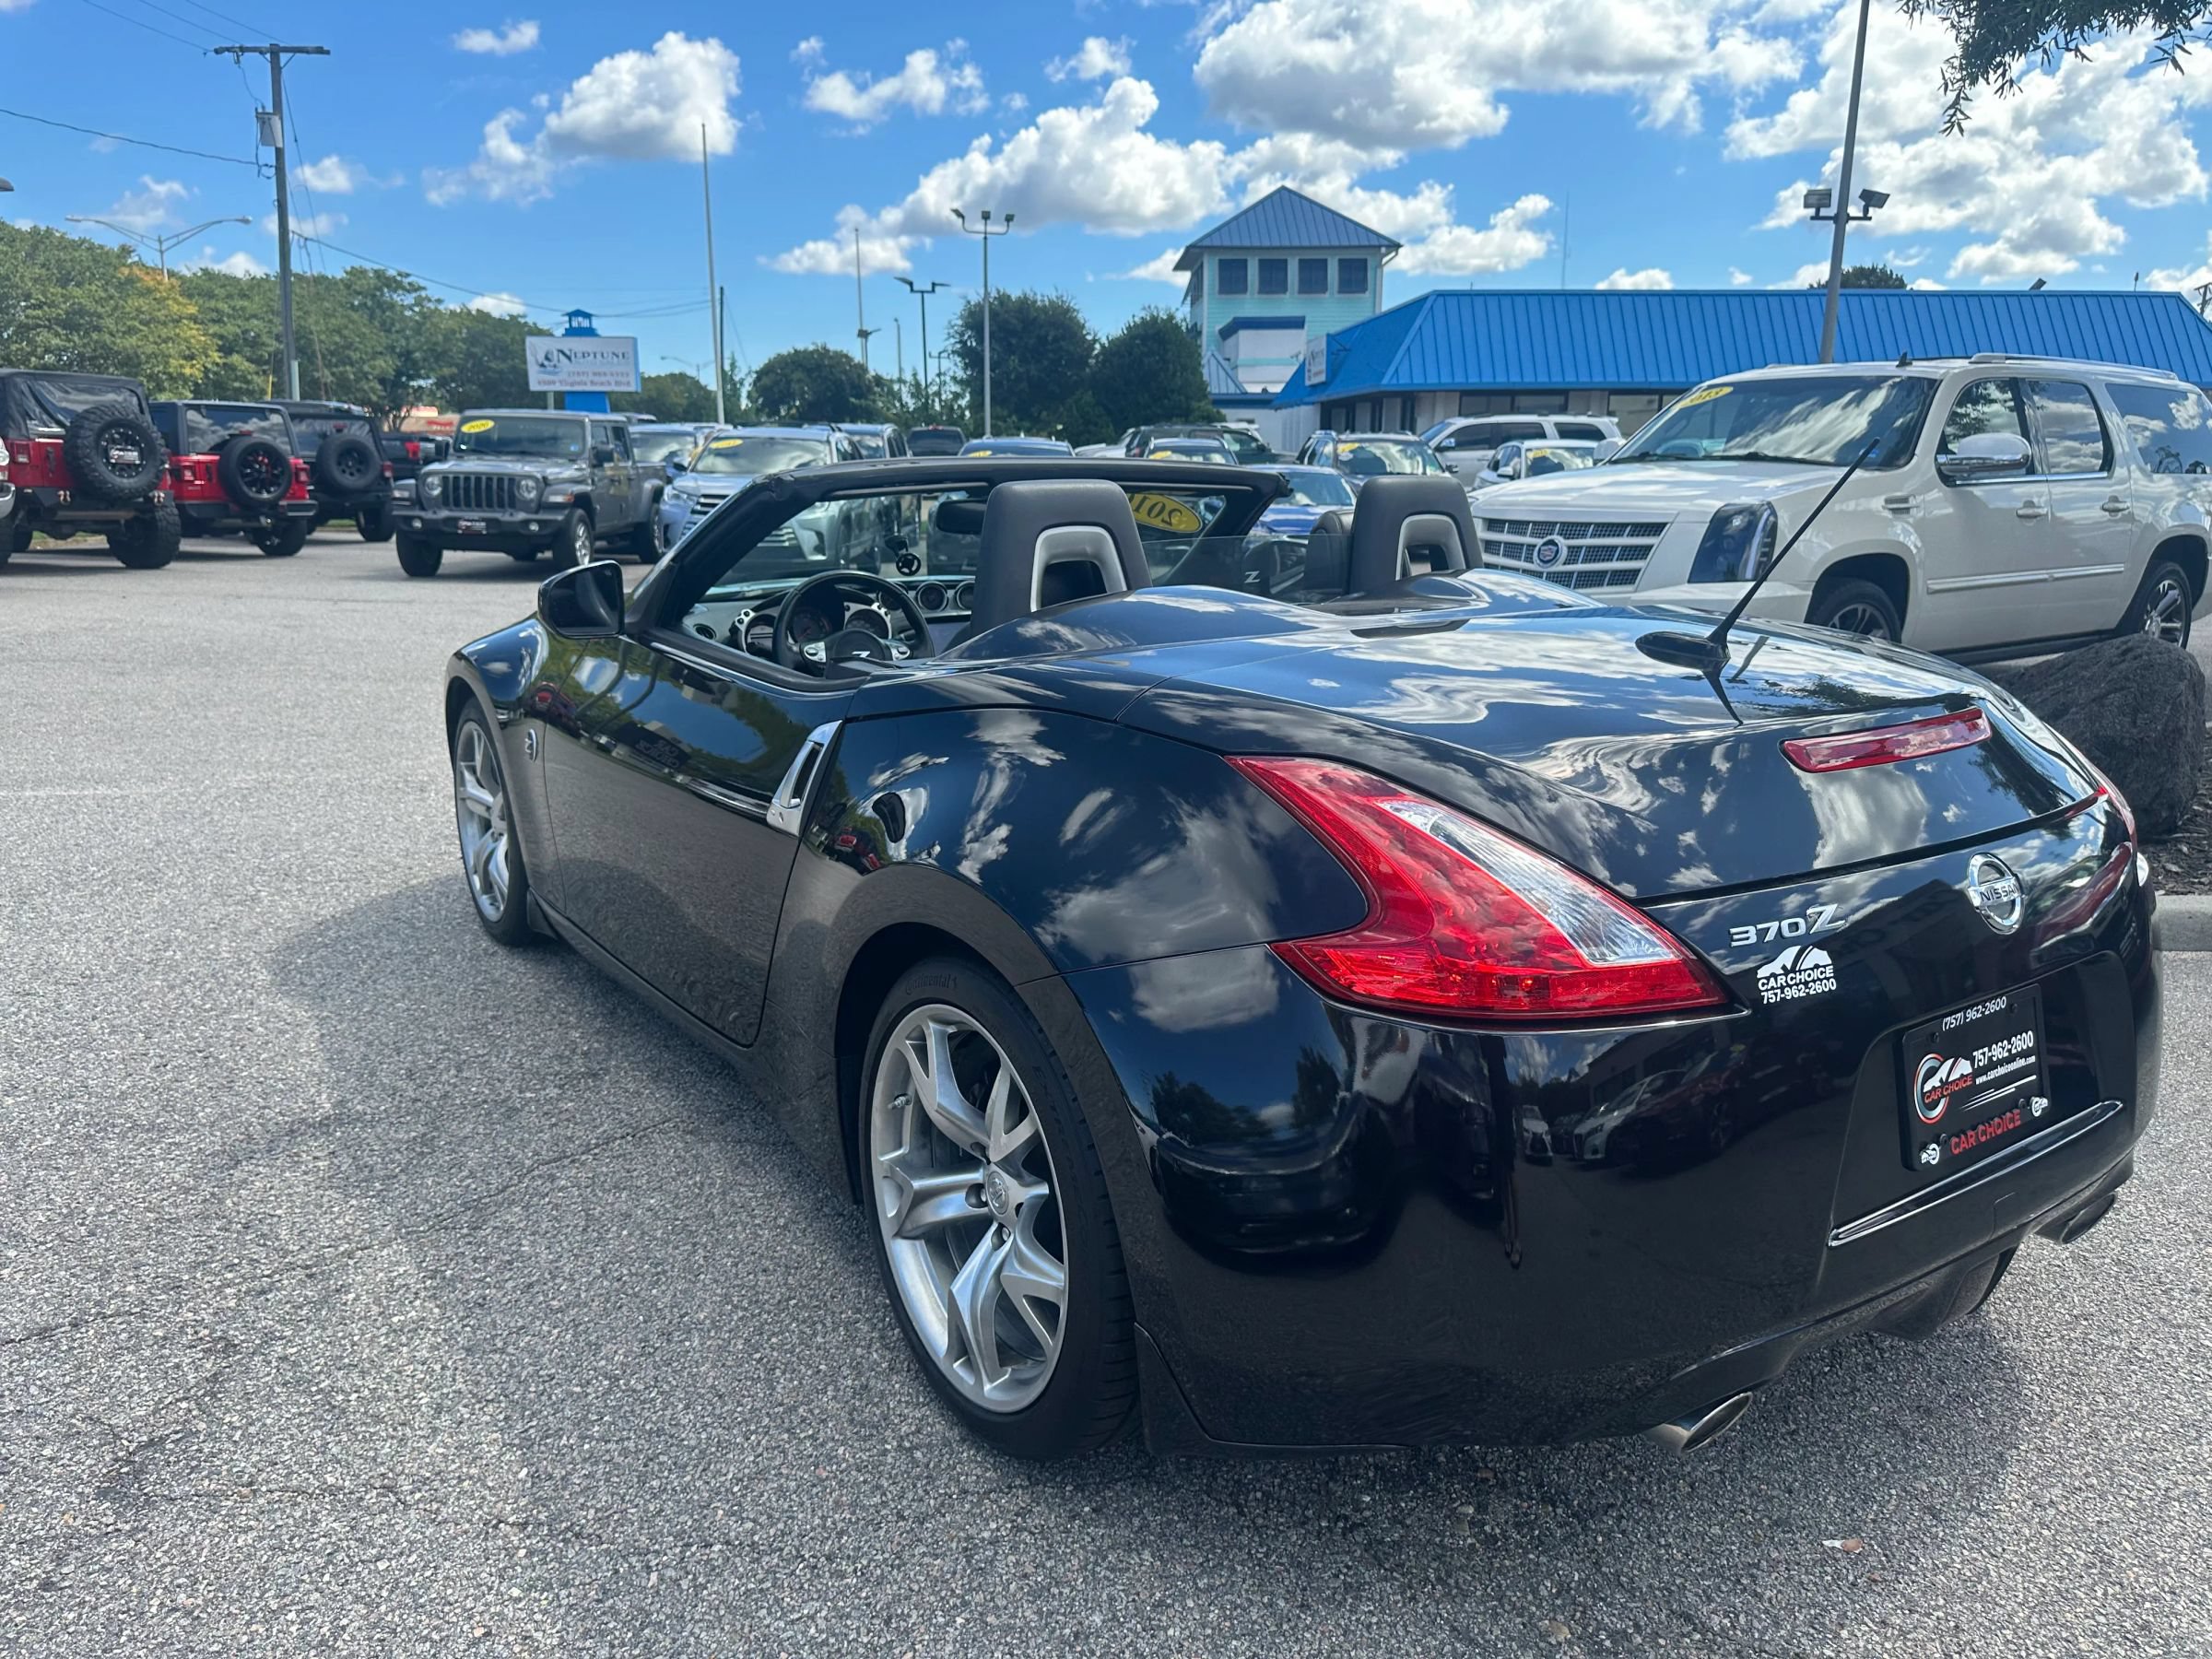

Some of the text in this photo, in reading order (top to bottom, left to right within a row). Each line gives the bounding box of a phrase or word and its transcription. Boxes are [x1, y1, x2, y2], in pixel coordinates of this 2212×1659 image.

[557, 348, 629, 364] NEPTUNE
[1244, 571, 1261, 583] Z
[1979, 883, 2018, 902] NISSAN
[1729, 903, 1846, 947] 370Z
[1760, 978, 1837, 1005] 757-962-2600
[1942, 996, 2007, 1031] (757) 962-2600
[1972, 1030, 2034, 1069] 757-962-2600
[1924, 1074, 1973, 1103] CAR CHOICE
[1950, 1110, 2021, 1155] CAR CHOICE
